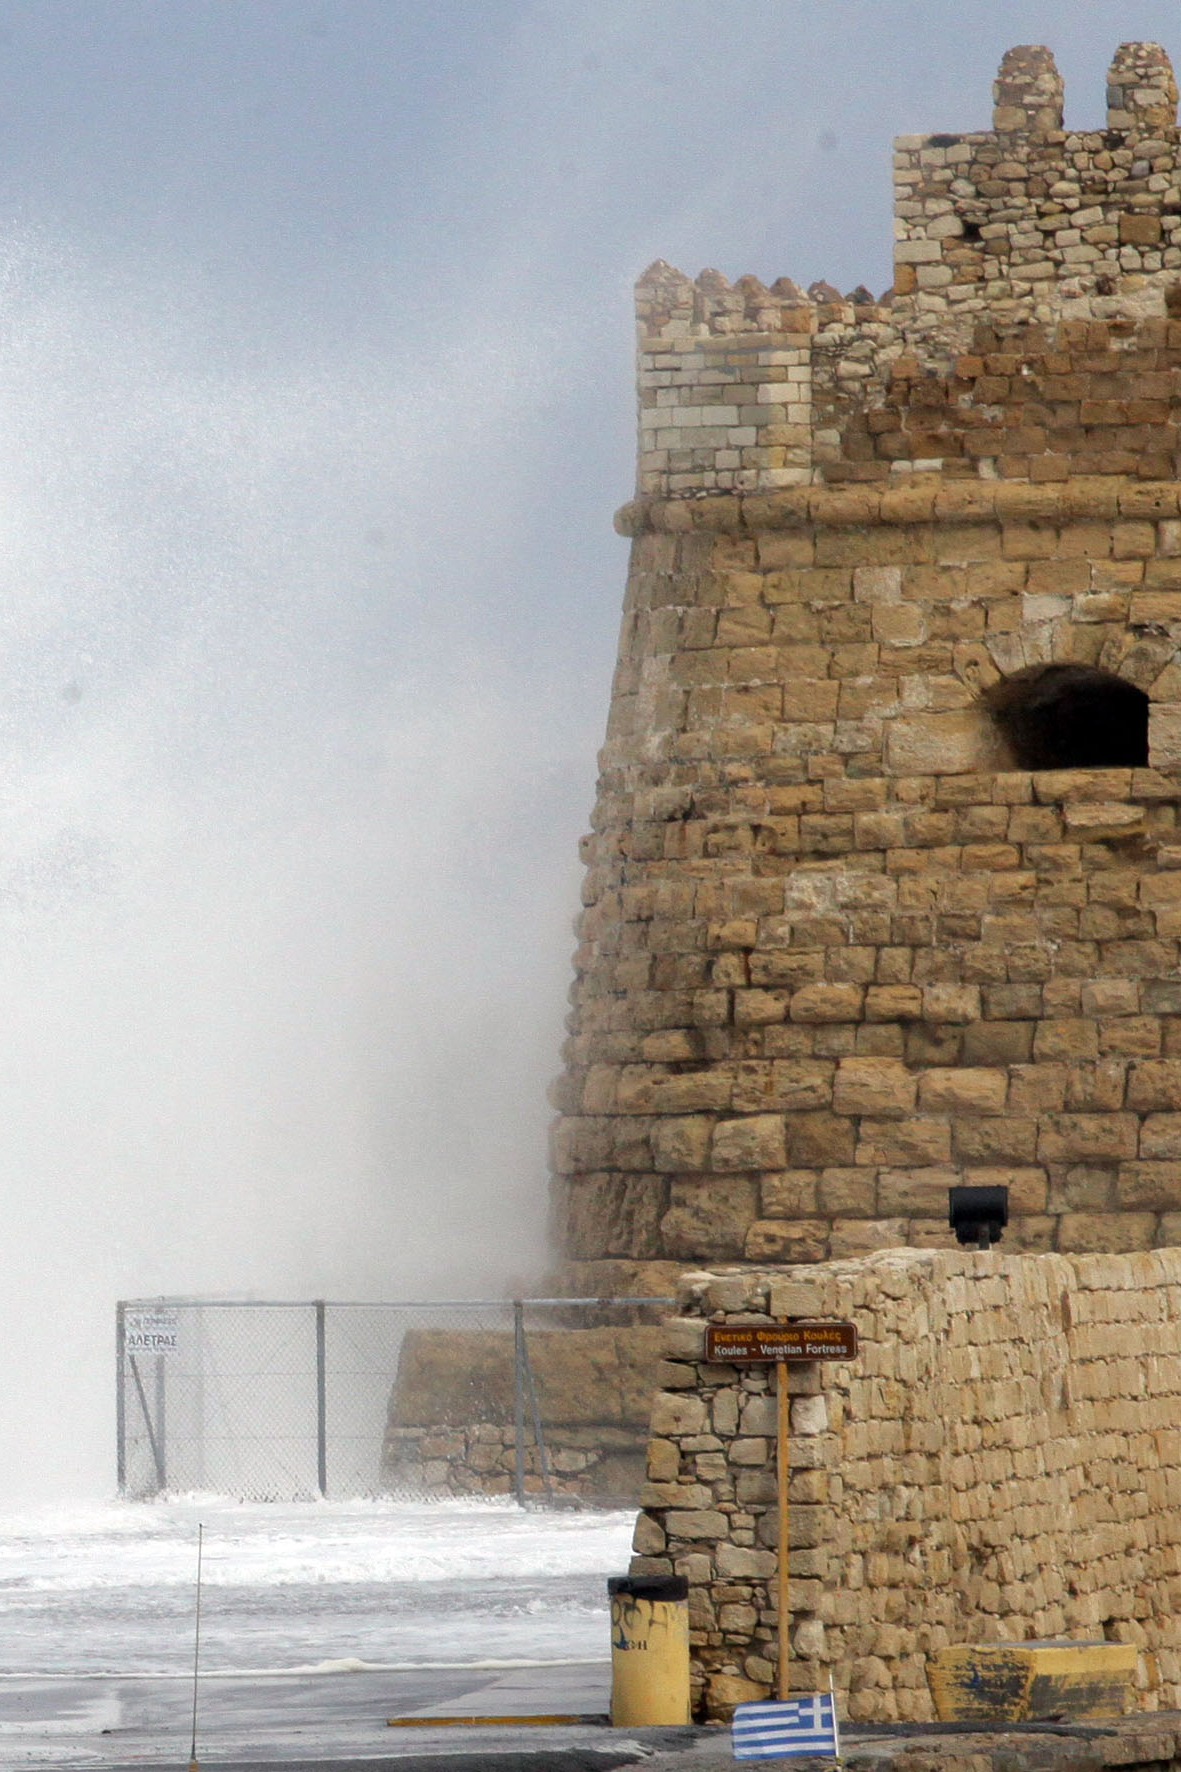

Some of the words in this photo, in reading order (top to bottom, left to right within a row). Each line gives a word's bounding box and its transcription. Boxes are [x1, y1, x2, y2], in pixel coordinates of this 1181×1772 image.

[714, 1345, 748, 1355] Koules
[760, 1343, 802, 1355] Venetian
[806, 1343, 848, 1354] Fortress
